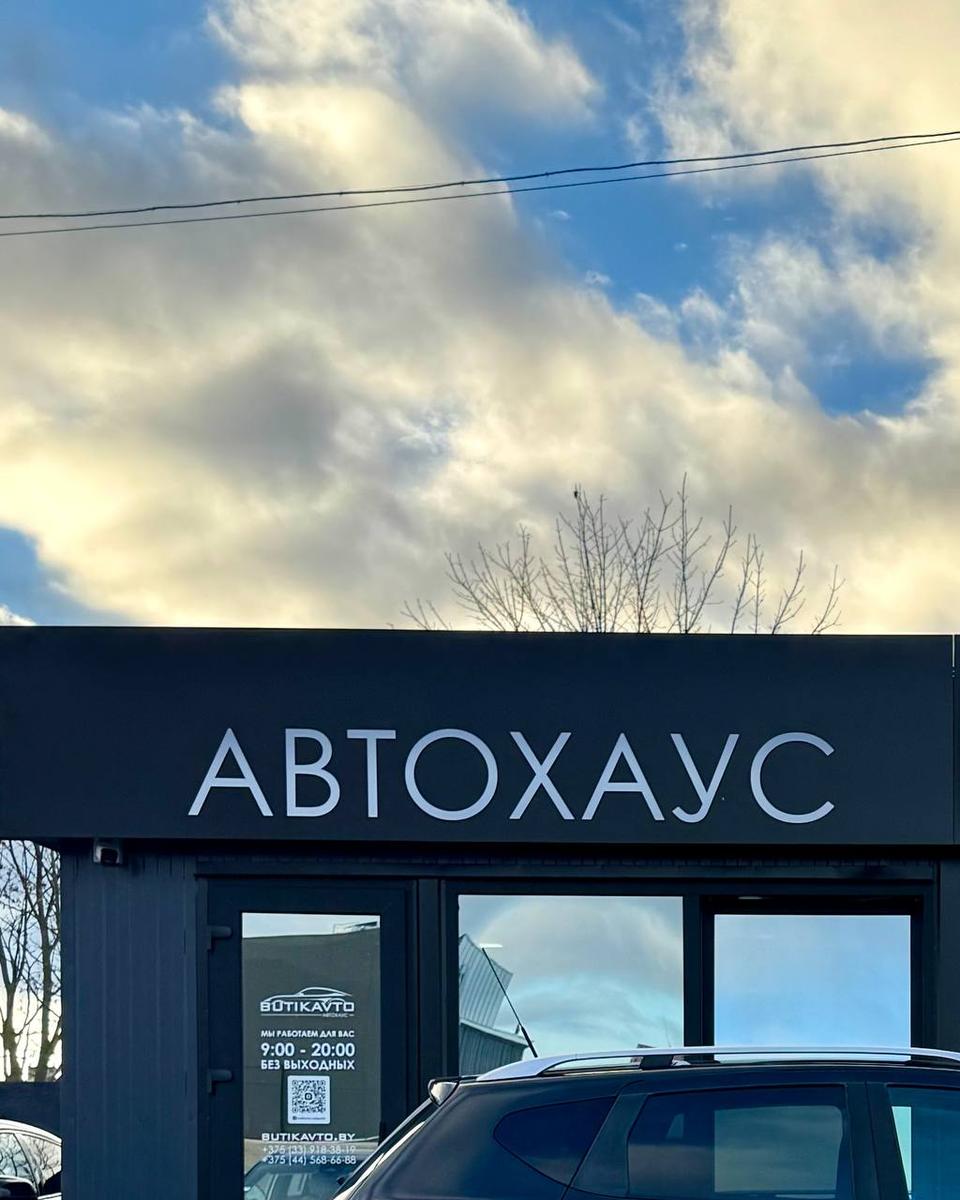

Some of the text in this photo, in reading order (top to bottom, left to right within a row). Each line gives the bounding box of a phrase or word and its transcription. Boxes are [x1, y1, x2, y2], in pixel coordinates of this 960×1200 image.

[188, 727, 835, 824] АВТОХАУС
[260, 1001, 355, 1012] BUTIKAVTO
[319, 1030, 336, 1038] ДЛЯ
[261, 1043, 295, 1056] 9:00
[311, 1043, 355, 1056] 20:00
[261, 1059, 355, 1071] БЕЗ ВЫХОДНЫХ
[261, 1132, 355, 1141] BUTIKAVTO.BY
[288, 1154, 307, 1166] (44)
[309, 1155, 356, 1164] 568-66-88
